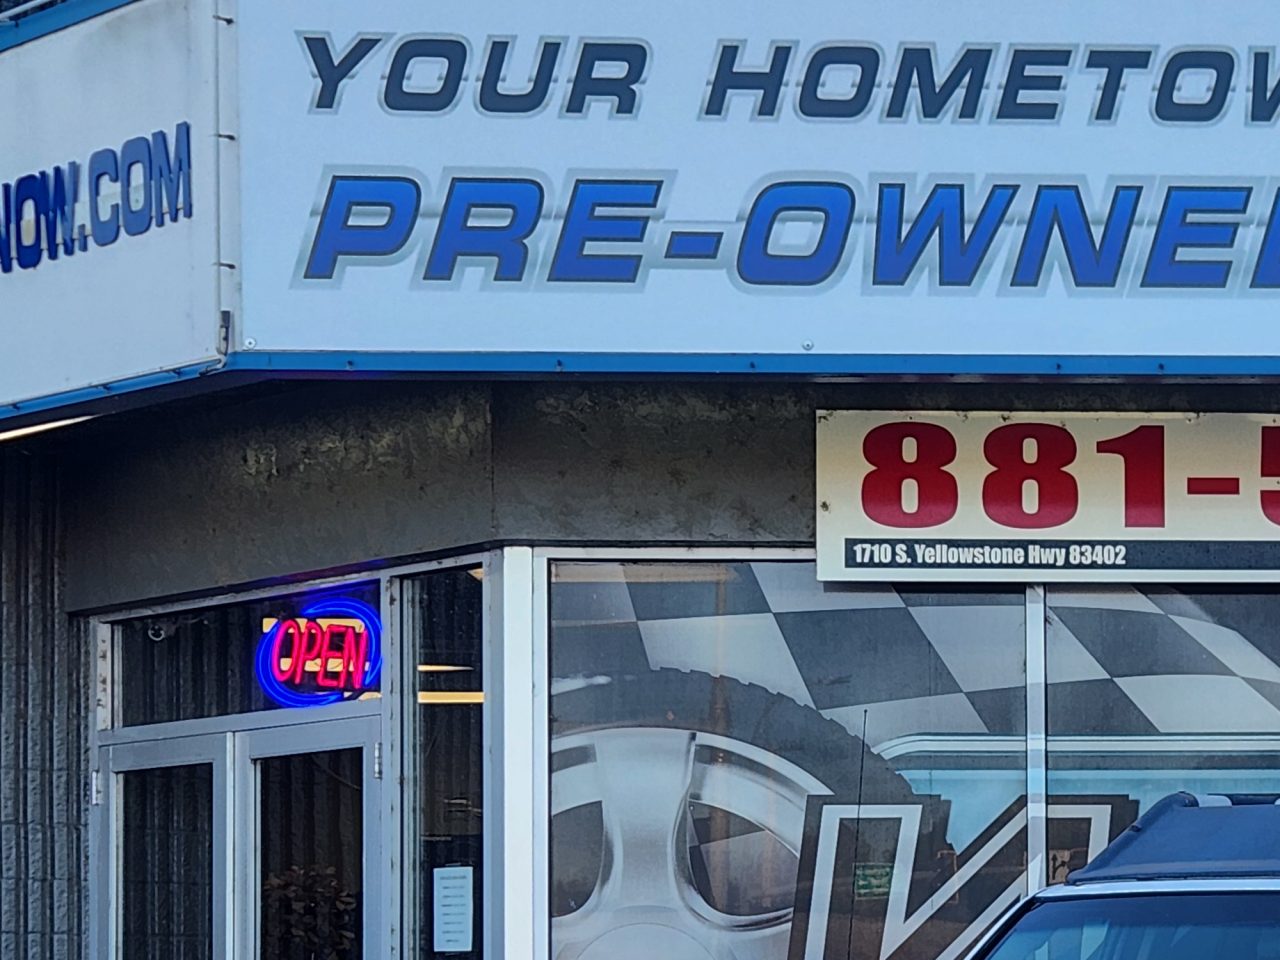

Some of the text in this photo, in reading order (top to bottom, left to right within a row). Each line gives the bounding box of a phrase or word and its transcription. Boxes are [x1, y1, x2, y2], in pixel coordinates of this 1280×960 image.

[301, 36, 649, 116] YOUR
[853, 543, 1127, 566] 1710 S. Yellowstone Hwy 83402
[271, 618, 369, 690] OPEN
